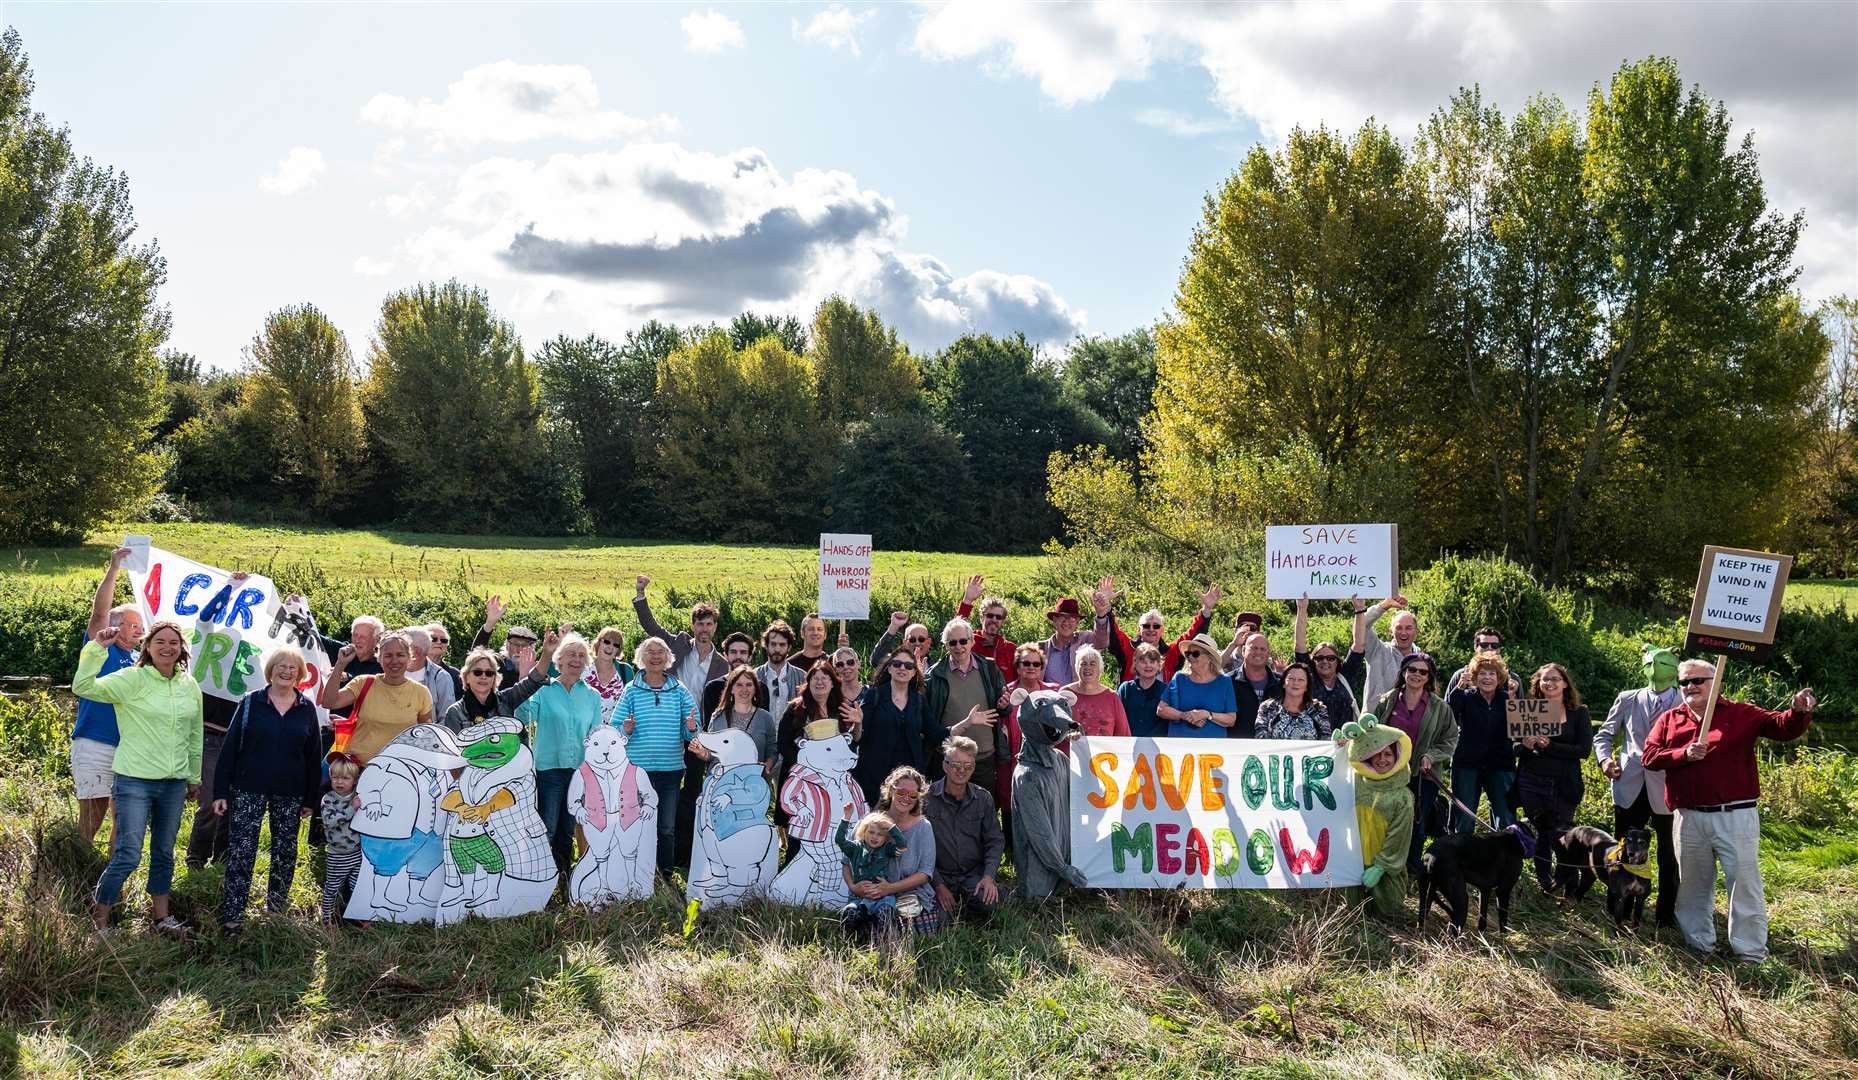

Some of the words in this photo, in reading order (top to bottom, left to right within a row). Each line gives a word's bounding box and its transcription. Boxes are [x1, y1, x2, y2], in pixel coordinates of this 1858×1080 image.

[1302, 527, 1360, 544] SAVE
[823, 539, 854, 556] HANDS
[855, 545, 871, 557] OFF
[1271, 549, 1358, 569] HAMBROOK
[1719, 558, 1747, 570] KEEP
[1750, 562, 1773, 574] THE
[823, 563, 871, 576] HAMBROOK
[836, 578, 869, 590] MARSH
[1310, 570, 1377, 588] MARSHES
[1718, 575, 1750, 587] WIND
[1753, 580, 1767, 589] IN
[174, 573, 265, 629] CAR
[1727, 595, 1749, 606] THE
[1707, 608, 1762, 624] WILLOWS
[1507, 700, 1549, 713] SAVE
[1520, 713, 1538, 722] the
[1510, 722, 1560, 736] MARSH
[1087, 752, 1226, 811] SAVE
[1241, 754, 1337, 811] OUR
[1110, 821, 1330, 877] MEADOW
